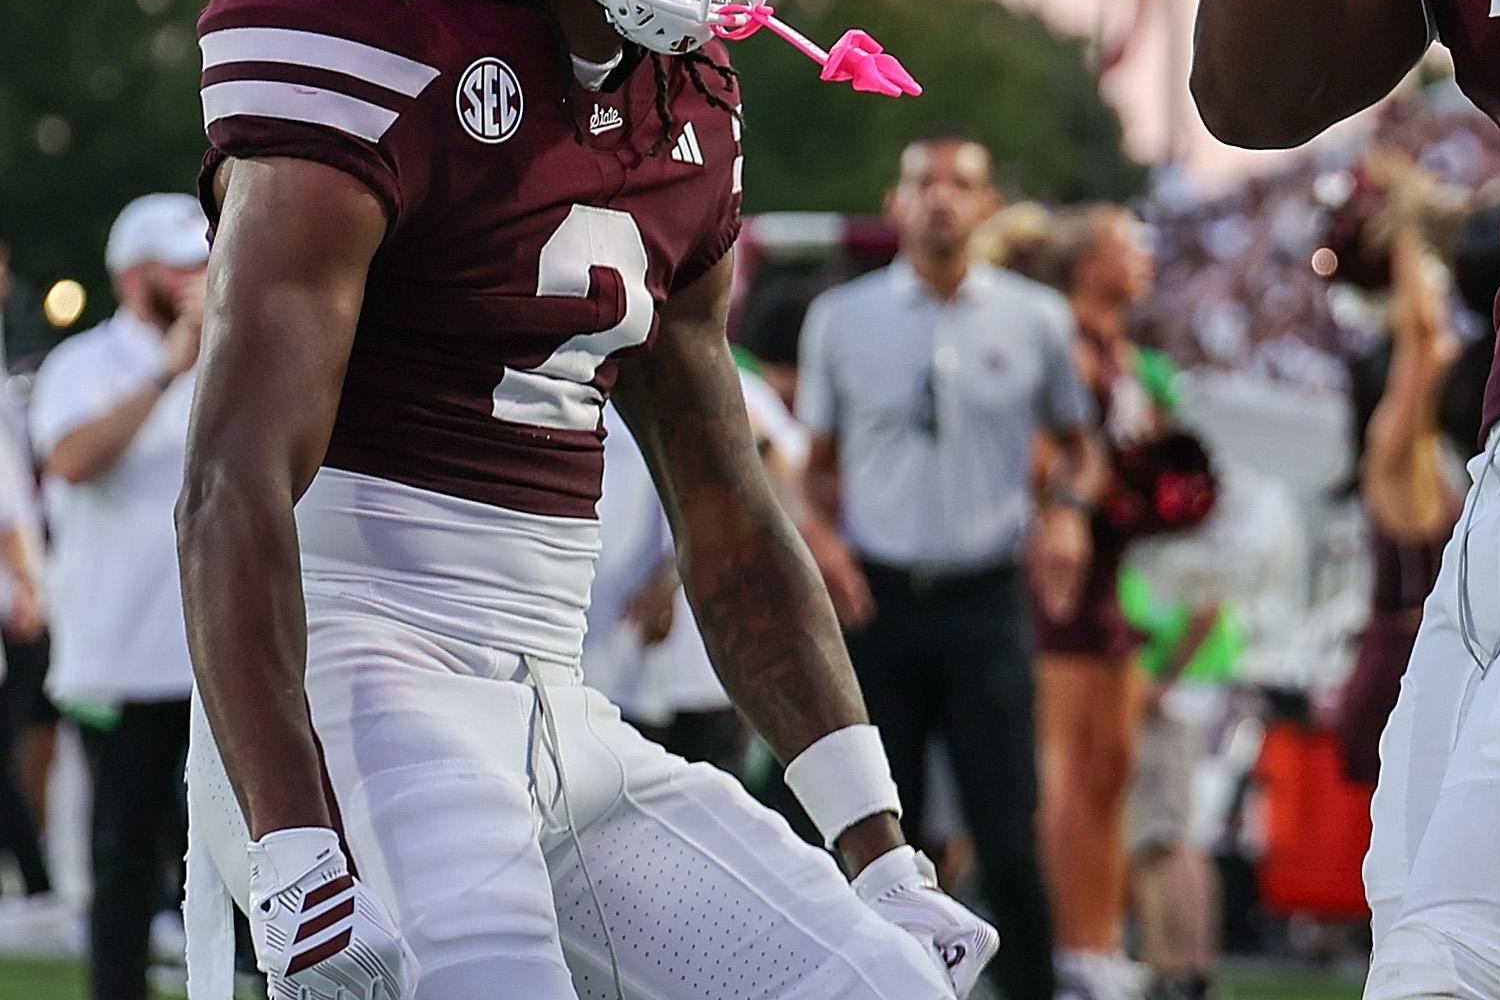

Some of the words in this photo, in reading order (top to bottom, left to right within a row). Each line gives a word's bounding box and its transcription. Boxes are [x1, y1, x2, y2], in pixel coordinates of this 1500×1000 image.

[462, 64, 517, 137] SEC
[589, 103, 623, 136] State
[491, 203, 654, 432] 2
